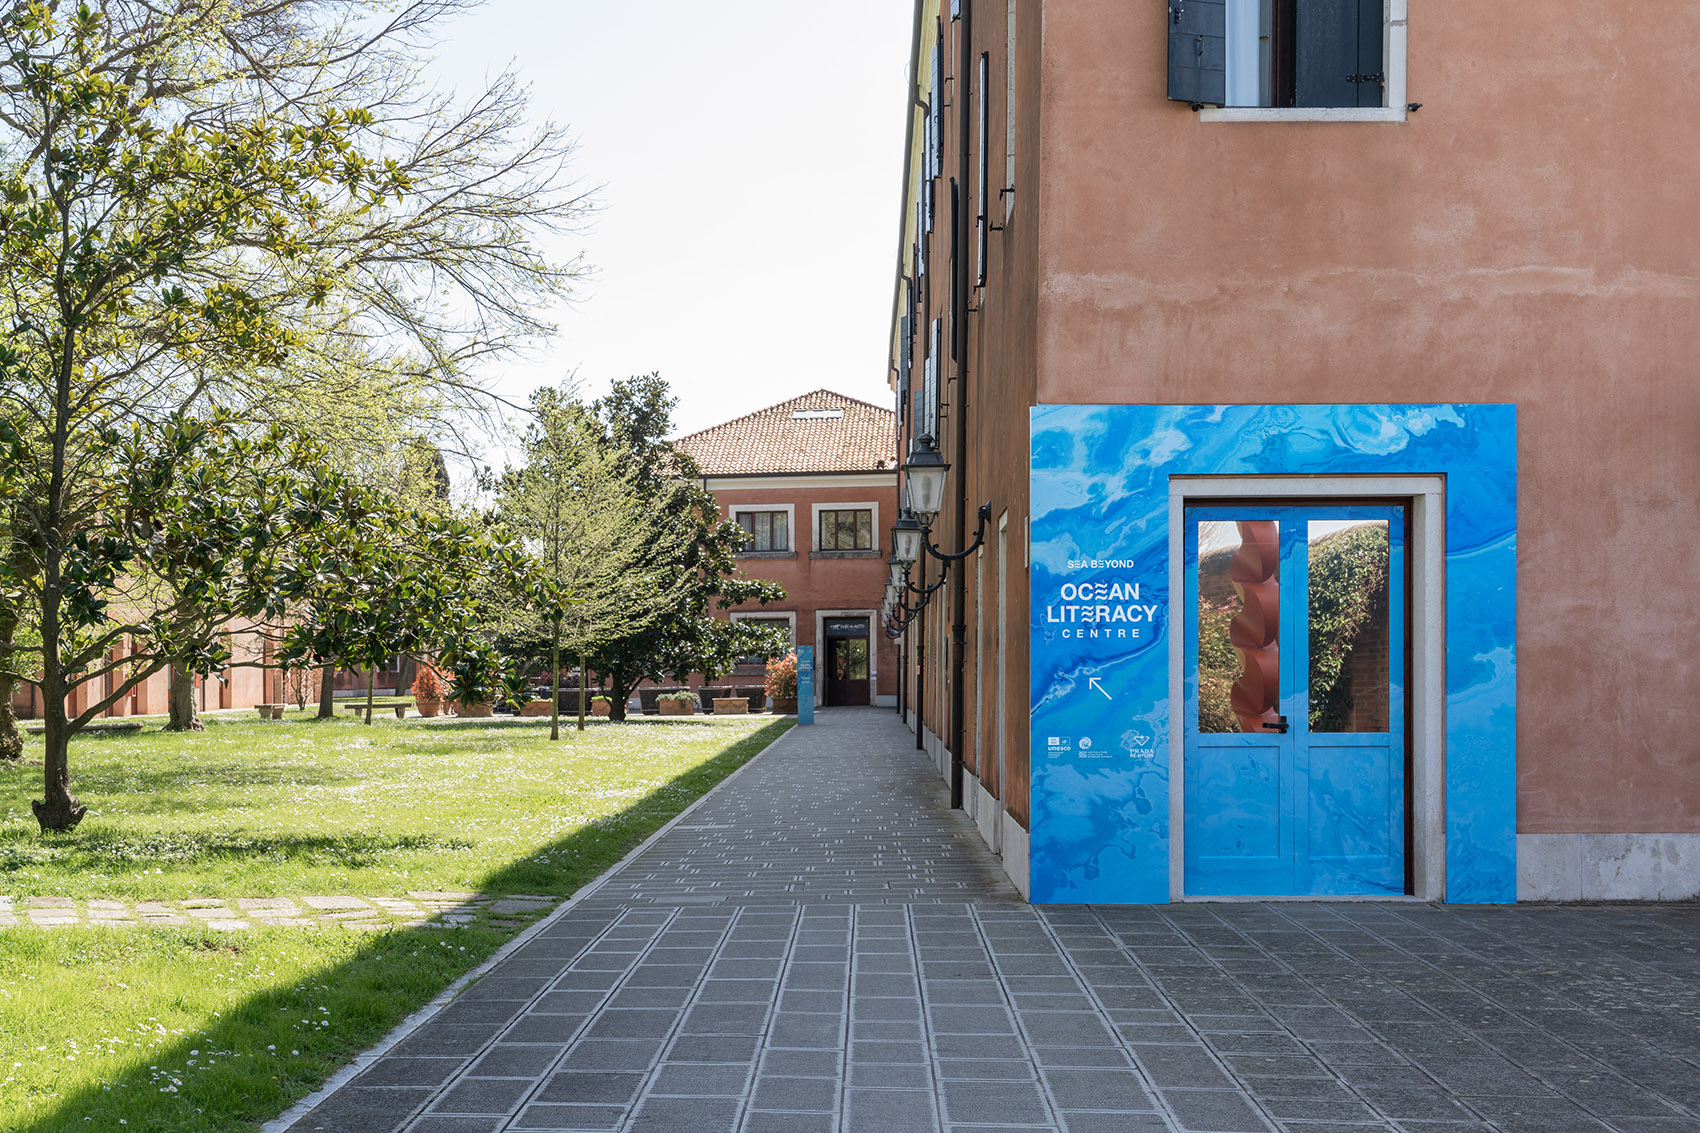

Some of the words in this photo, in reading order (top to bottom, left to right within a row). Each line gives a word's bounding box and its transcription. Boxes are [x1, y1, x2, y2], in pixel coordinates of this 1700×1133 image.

[1067, 559, 1088, 569] SEA
[1091, 559, 1134, 569] BEYOND
[1060, 583, 1140, 601] OCEAN
[1047, 605, 1158, 622] LITERACY
[1062, 628, 1140, 638] CENTRE
